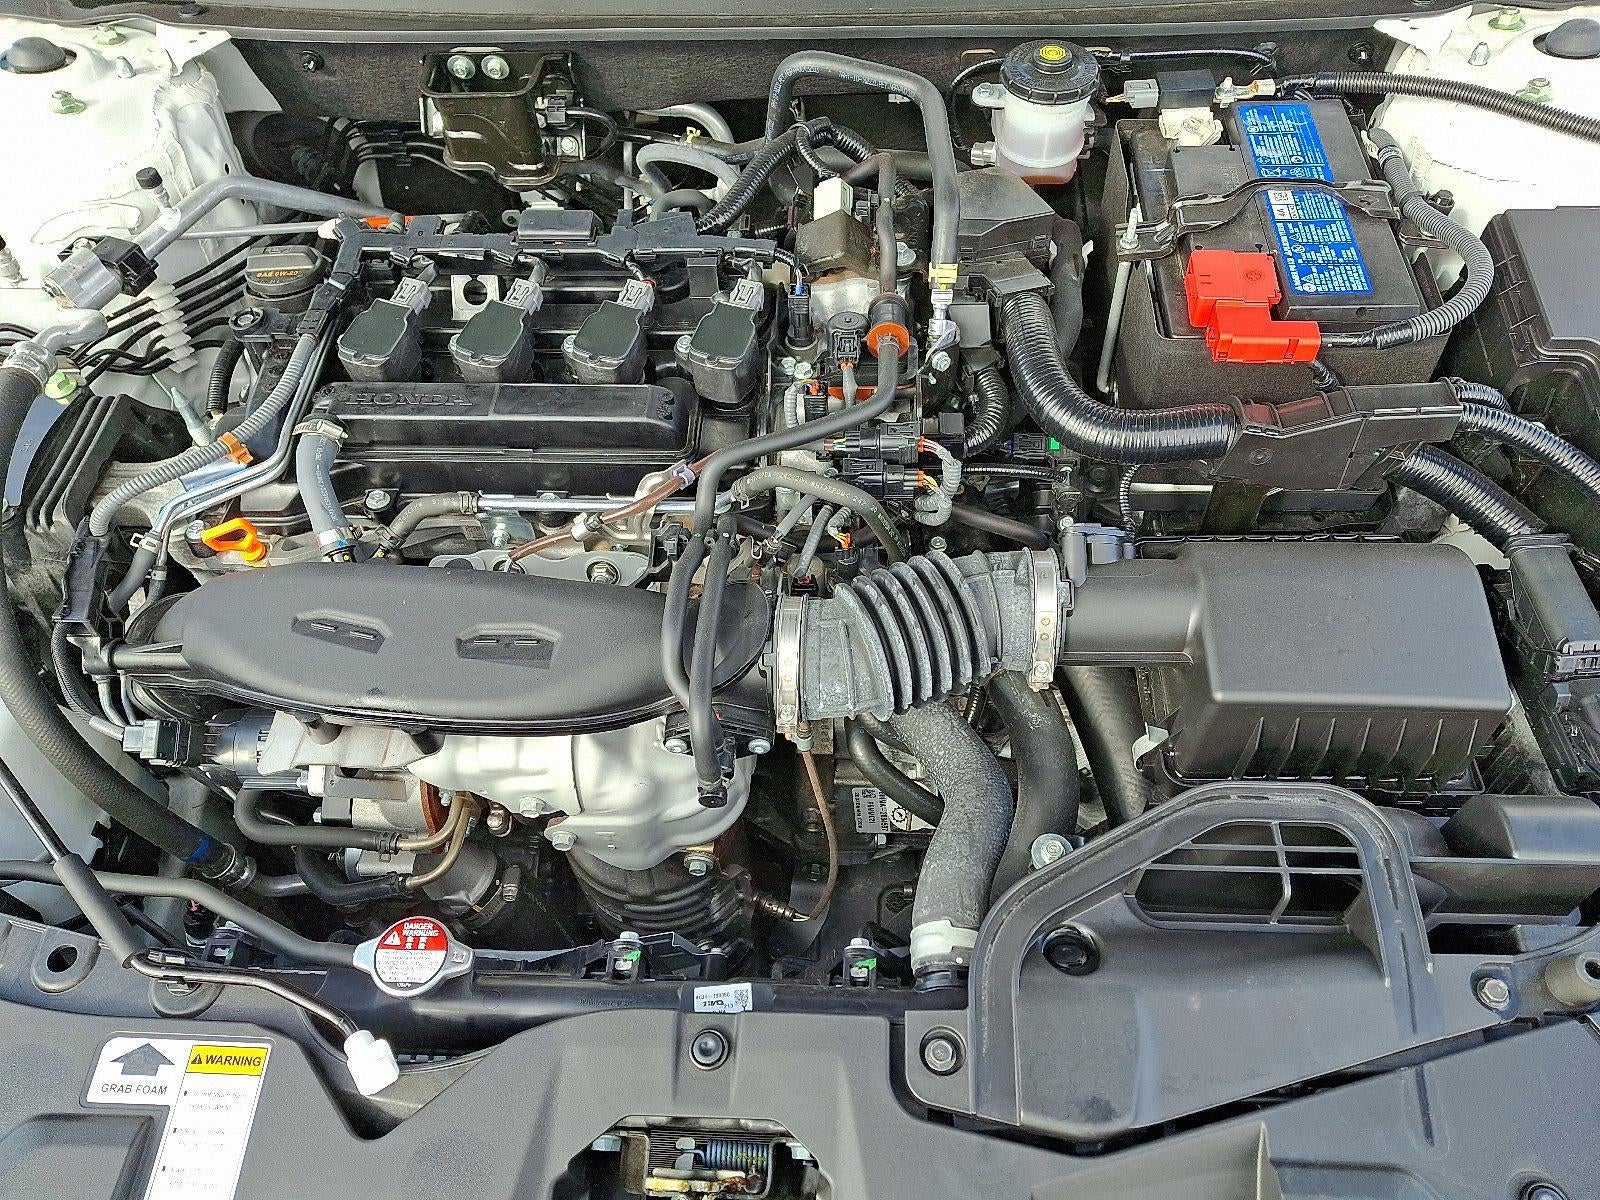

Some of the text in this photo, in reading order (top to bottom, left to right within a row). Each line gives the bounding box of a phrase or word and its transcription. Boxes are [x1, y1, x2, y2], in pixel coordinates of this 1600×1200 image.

[345, 393, 473, 406] HONDA
[403, 922, 434, 930] DANGER
[205, 1053, 262, 1067] WARNING
[101, 1083, 168, 1095] GRAB FOAM
